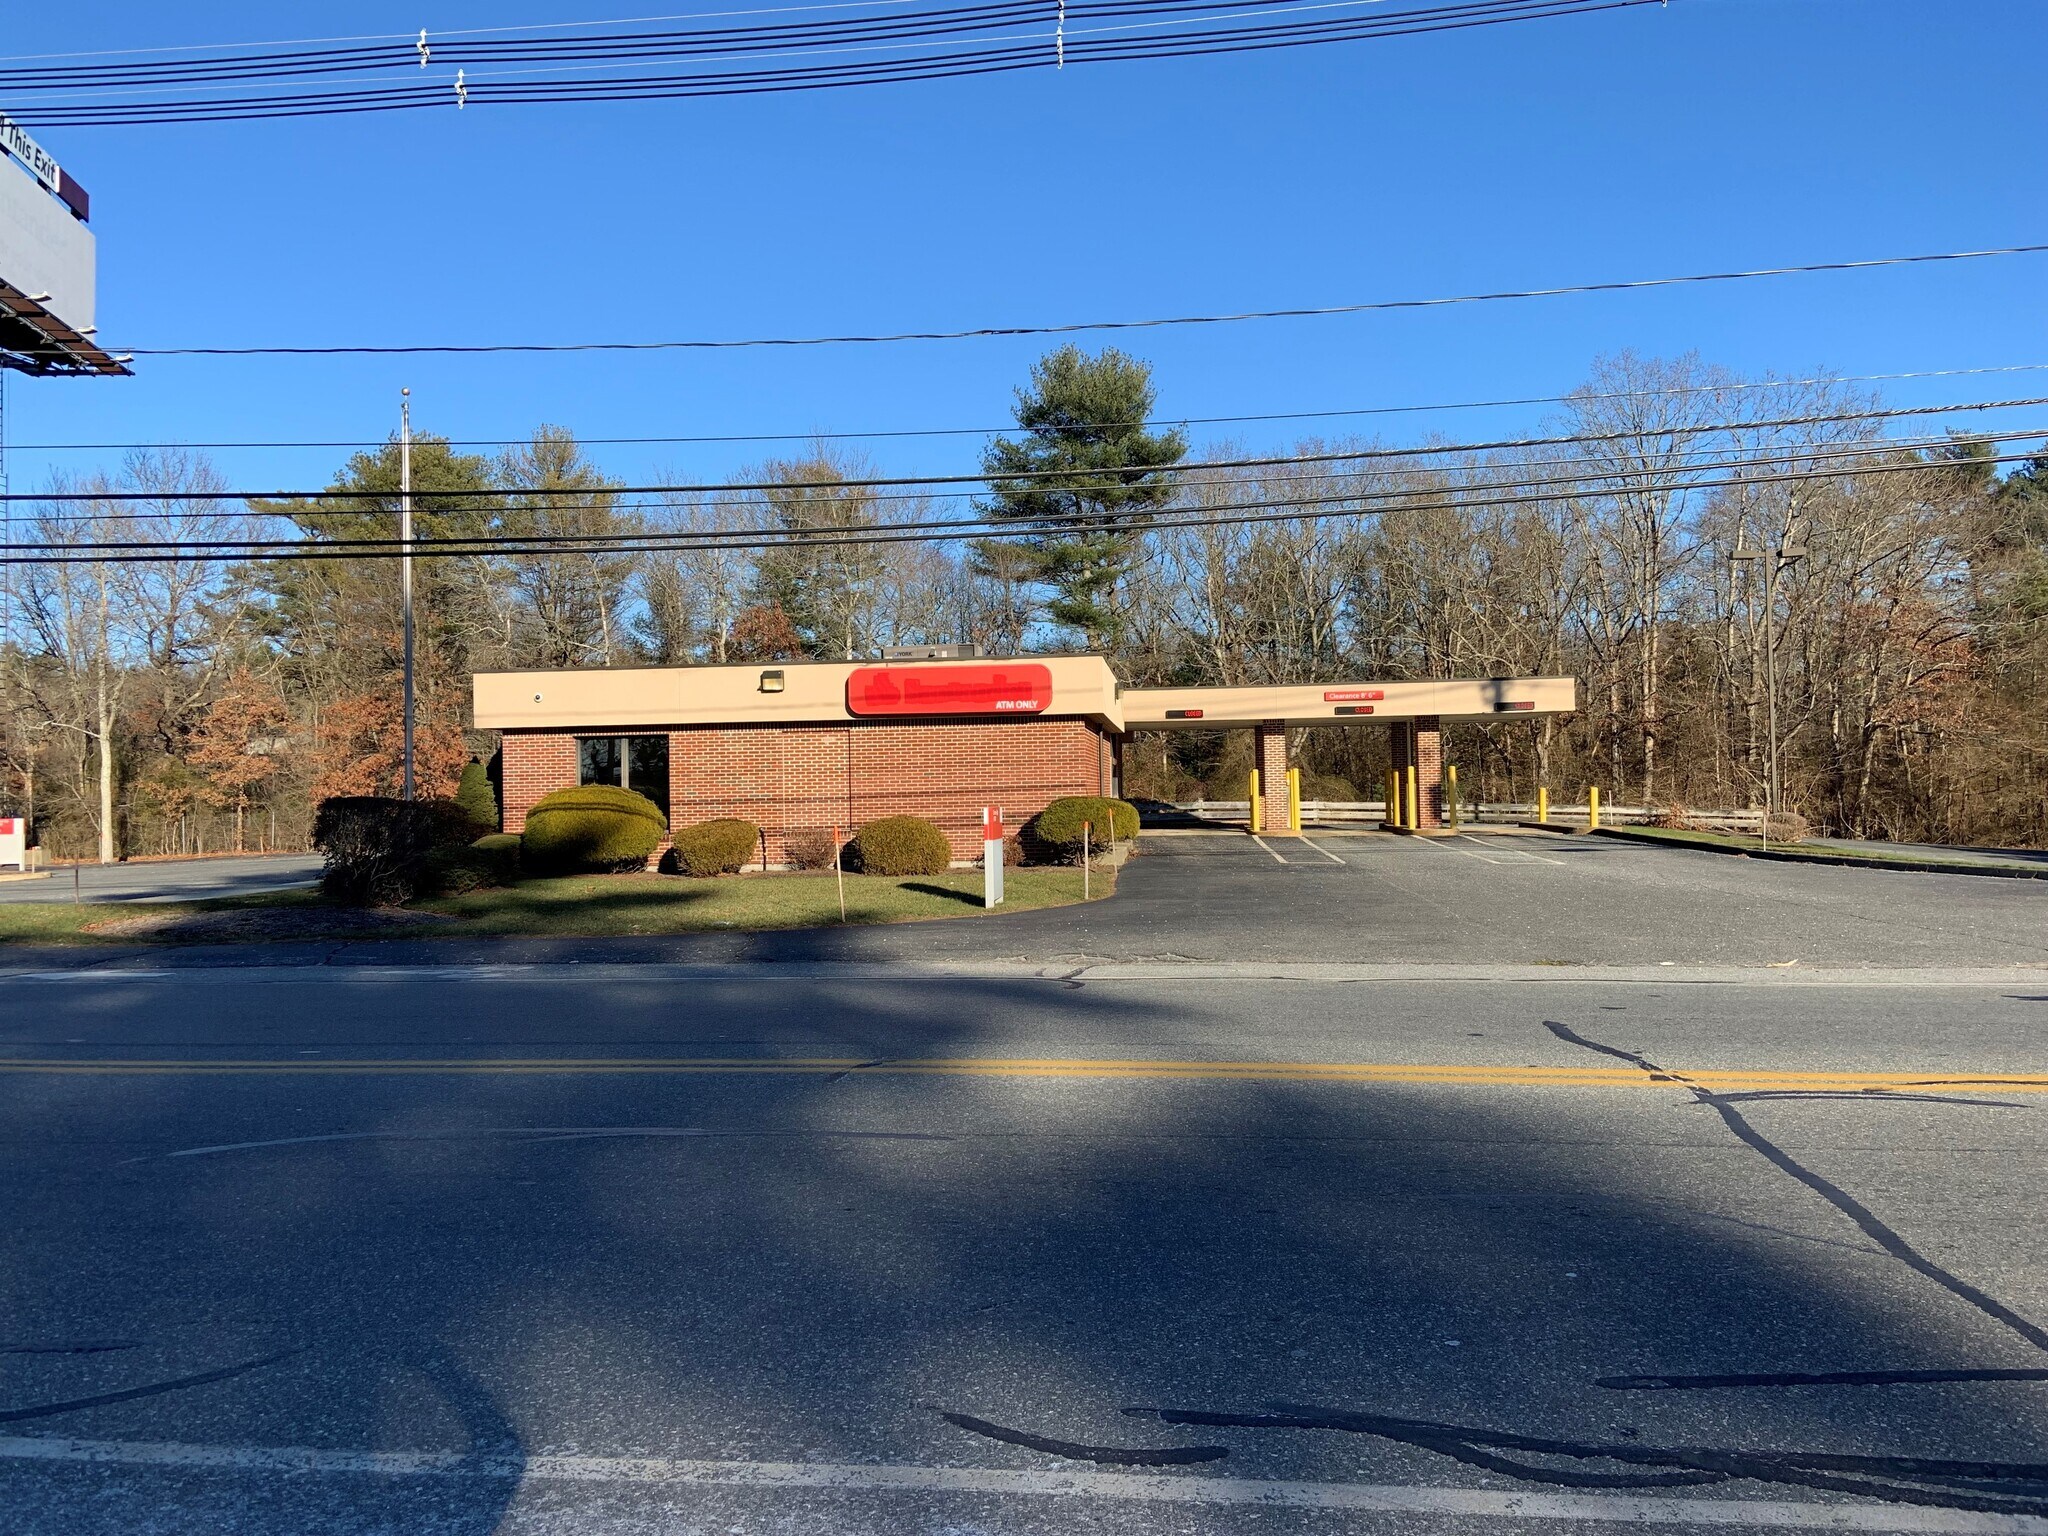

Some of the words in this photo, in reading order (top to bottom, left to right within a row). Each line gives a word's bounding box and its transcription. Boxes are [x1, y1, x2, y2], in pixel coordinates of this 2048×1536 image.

[9, 121, 32, 160] This
[34, 147, 56, 184] Exit
[996, 701, 1015, 709] ATM
[1016, 700, 1038, 709] ONLY
[1184, 710, 1202, 718] CLOSED
